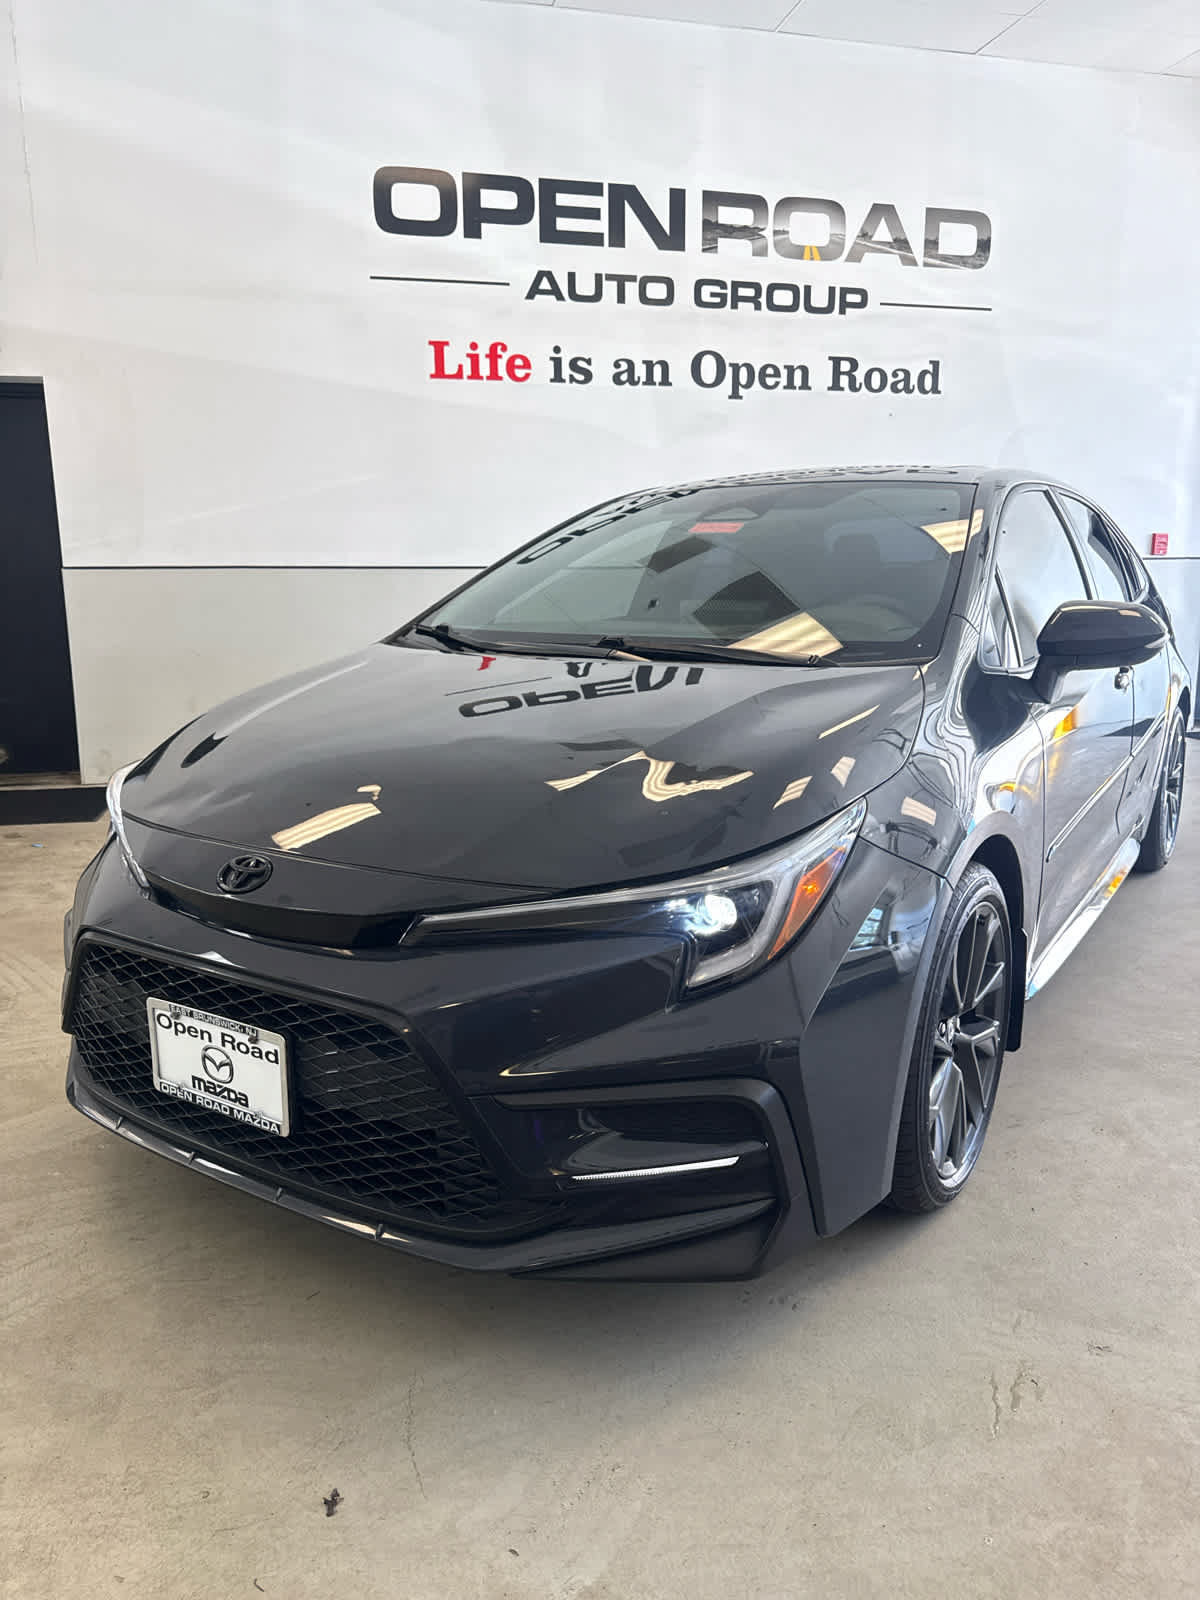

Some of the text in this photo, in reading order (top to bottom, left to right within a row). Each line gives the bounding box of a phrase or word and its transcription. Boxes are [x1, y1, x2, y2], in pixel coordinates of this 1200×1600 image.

[372, 166, 992, 271] OPEN ROAD
[525, 269, 869, 316] AUTO GROUP
[428, 340, 942, 400] Life is an Open Road
[156, 1013, 279, 1065] Open Road
[160, 1082, 280, 1134] OPEN ROAD MAZDA
